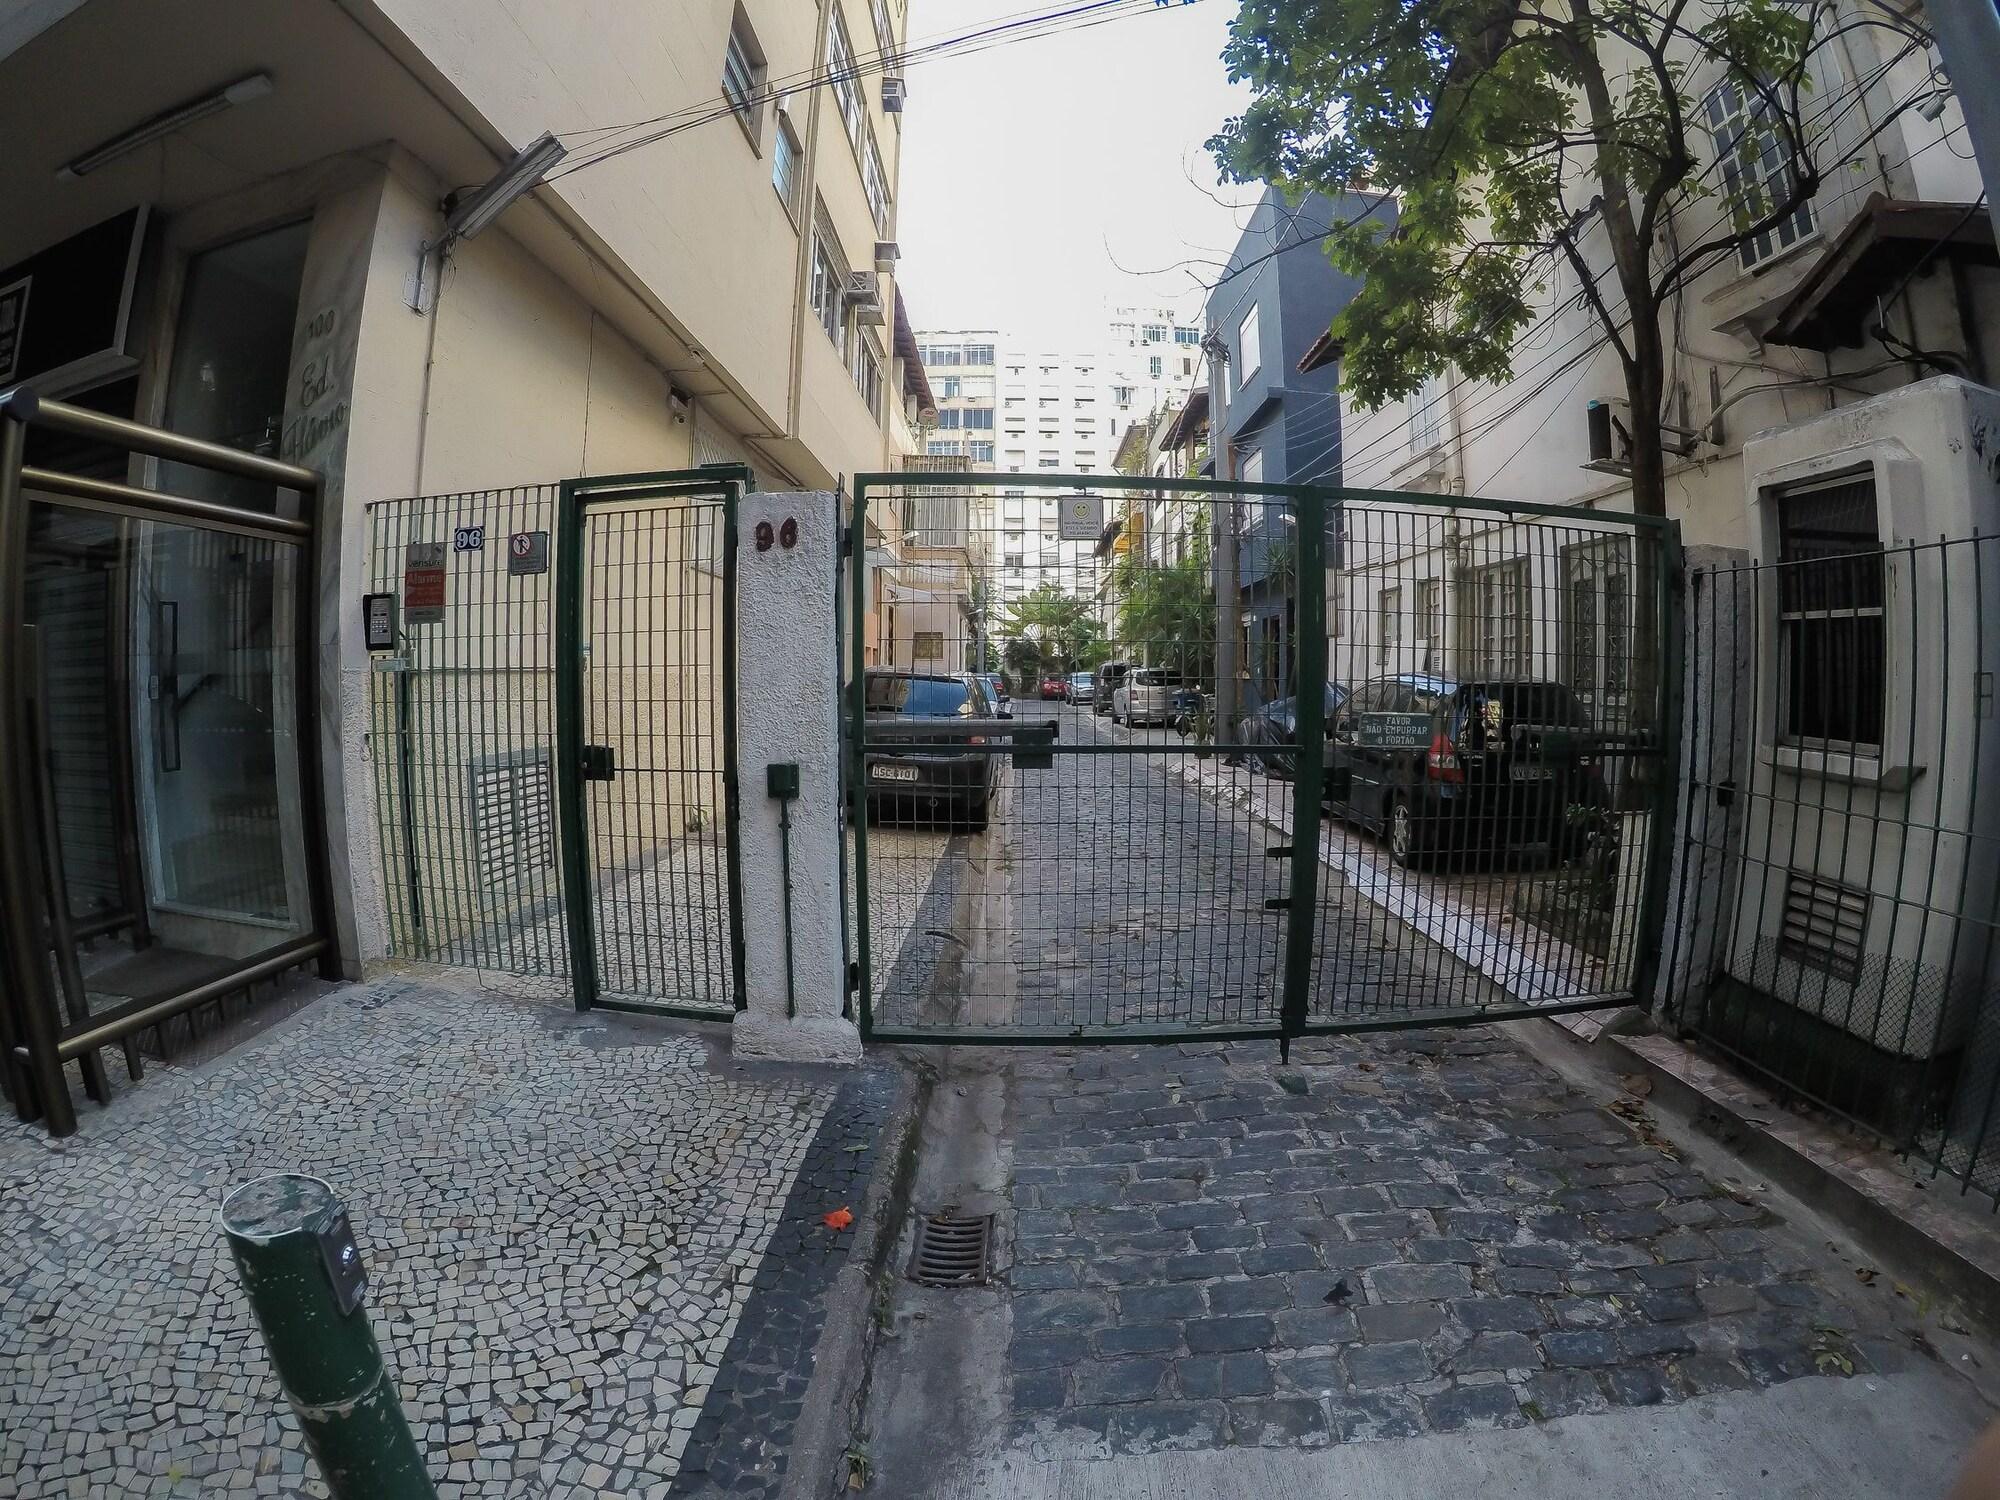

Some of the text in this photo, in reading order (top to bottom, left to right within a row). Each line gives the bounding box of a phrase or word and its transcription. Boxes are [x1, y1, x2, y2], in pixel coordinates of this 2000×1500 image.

[307, 309, 335, 338] 100
[302, 354, 334, 408] Ed.
[456, 530, 482, 547] 96
[407, 572, 441, 585] Alarme
[1386, 717, 1411, 725] FAVOR
[1366, 723, 1428, 735] NÃO EMPURRAR
[1378, 735, 1415, 745] O PORTÃO
